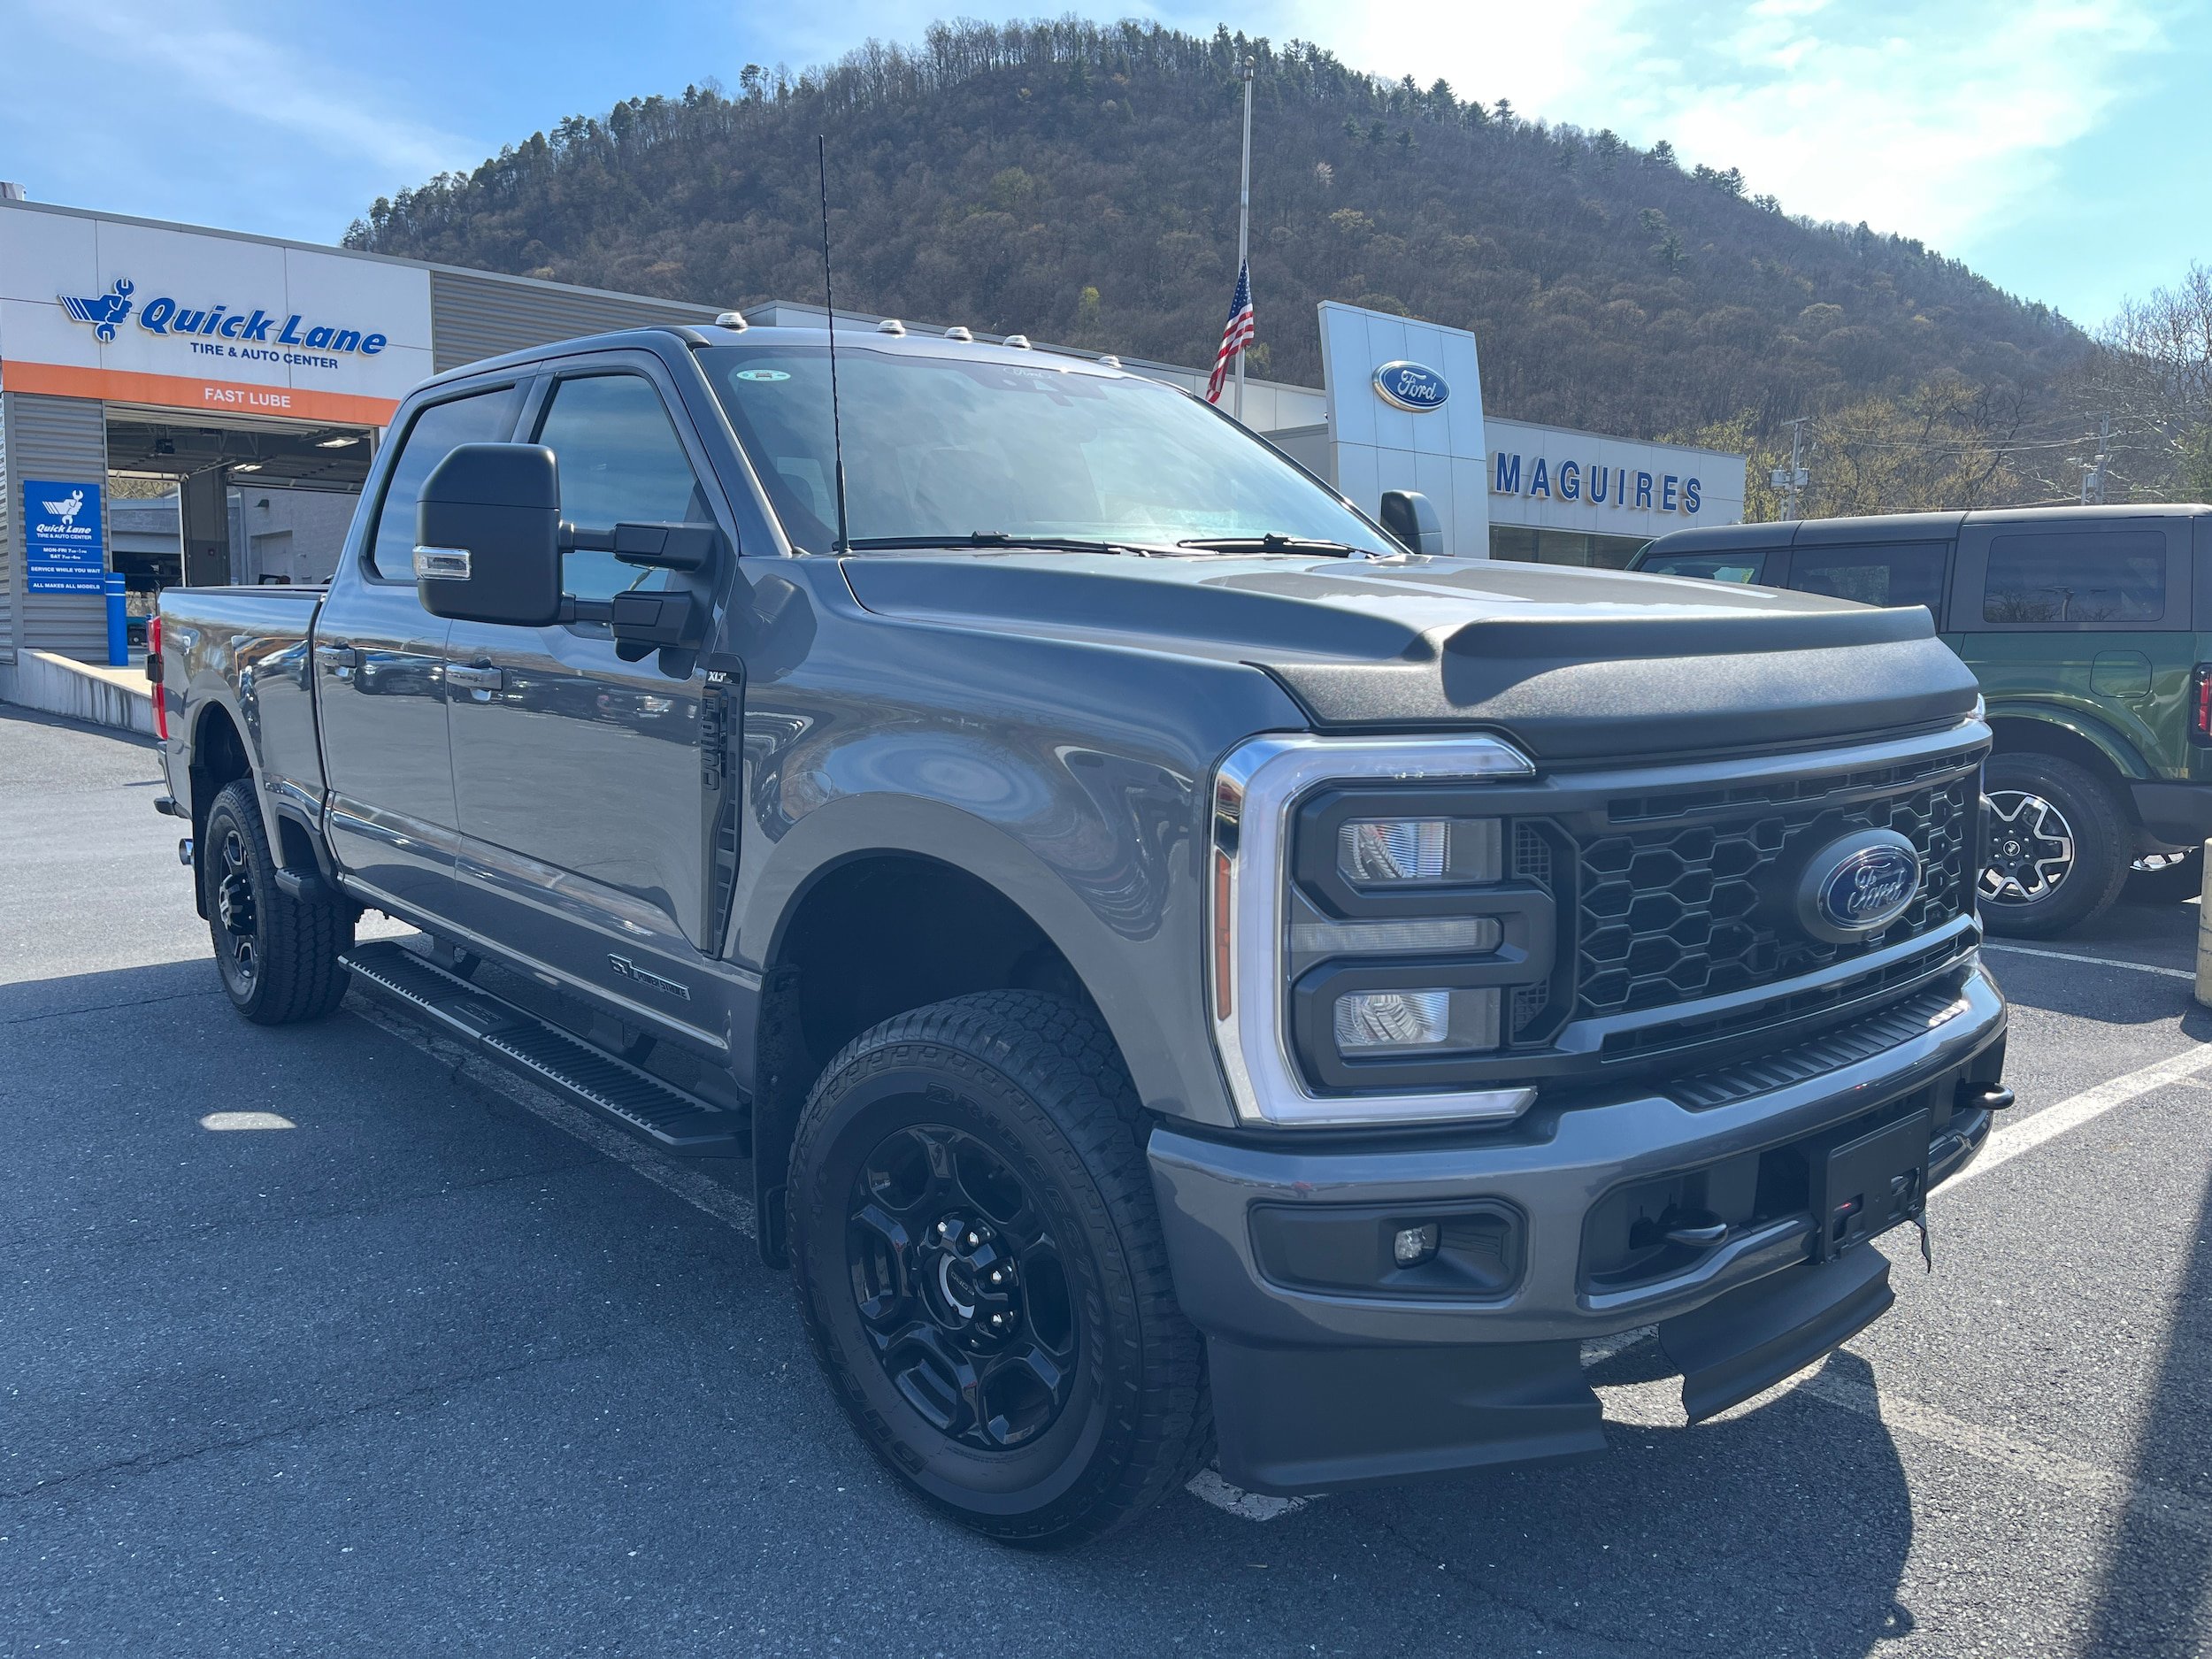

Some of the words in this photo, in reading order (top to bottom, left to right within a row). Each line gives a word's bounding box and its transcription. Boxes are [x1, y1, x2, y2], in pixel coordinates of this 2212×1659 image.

[139, 296, 273, 341] Quick
[279, 313, 388, 356] Lane
[190, 342, 224, 356] TIRE
[228, 346, 237, 357] &
[241, 348, 280, 362] AUTO
[283, 353, 339, 369] CENTER
[204, 387, 244, 404] FAST
[250, 390, 291, 408] LUBE
[1397, 368, 1438, 401] Ford
[1494, 451, 1701, 515] MAGUIRES
[36, 524, 65, 533] Quick
[708, 671, 726, 683] XLT
[1847, 861, 1908, 914] Ford
